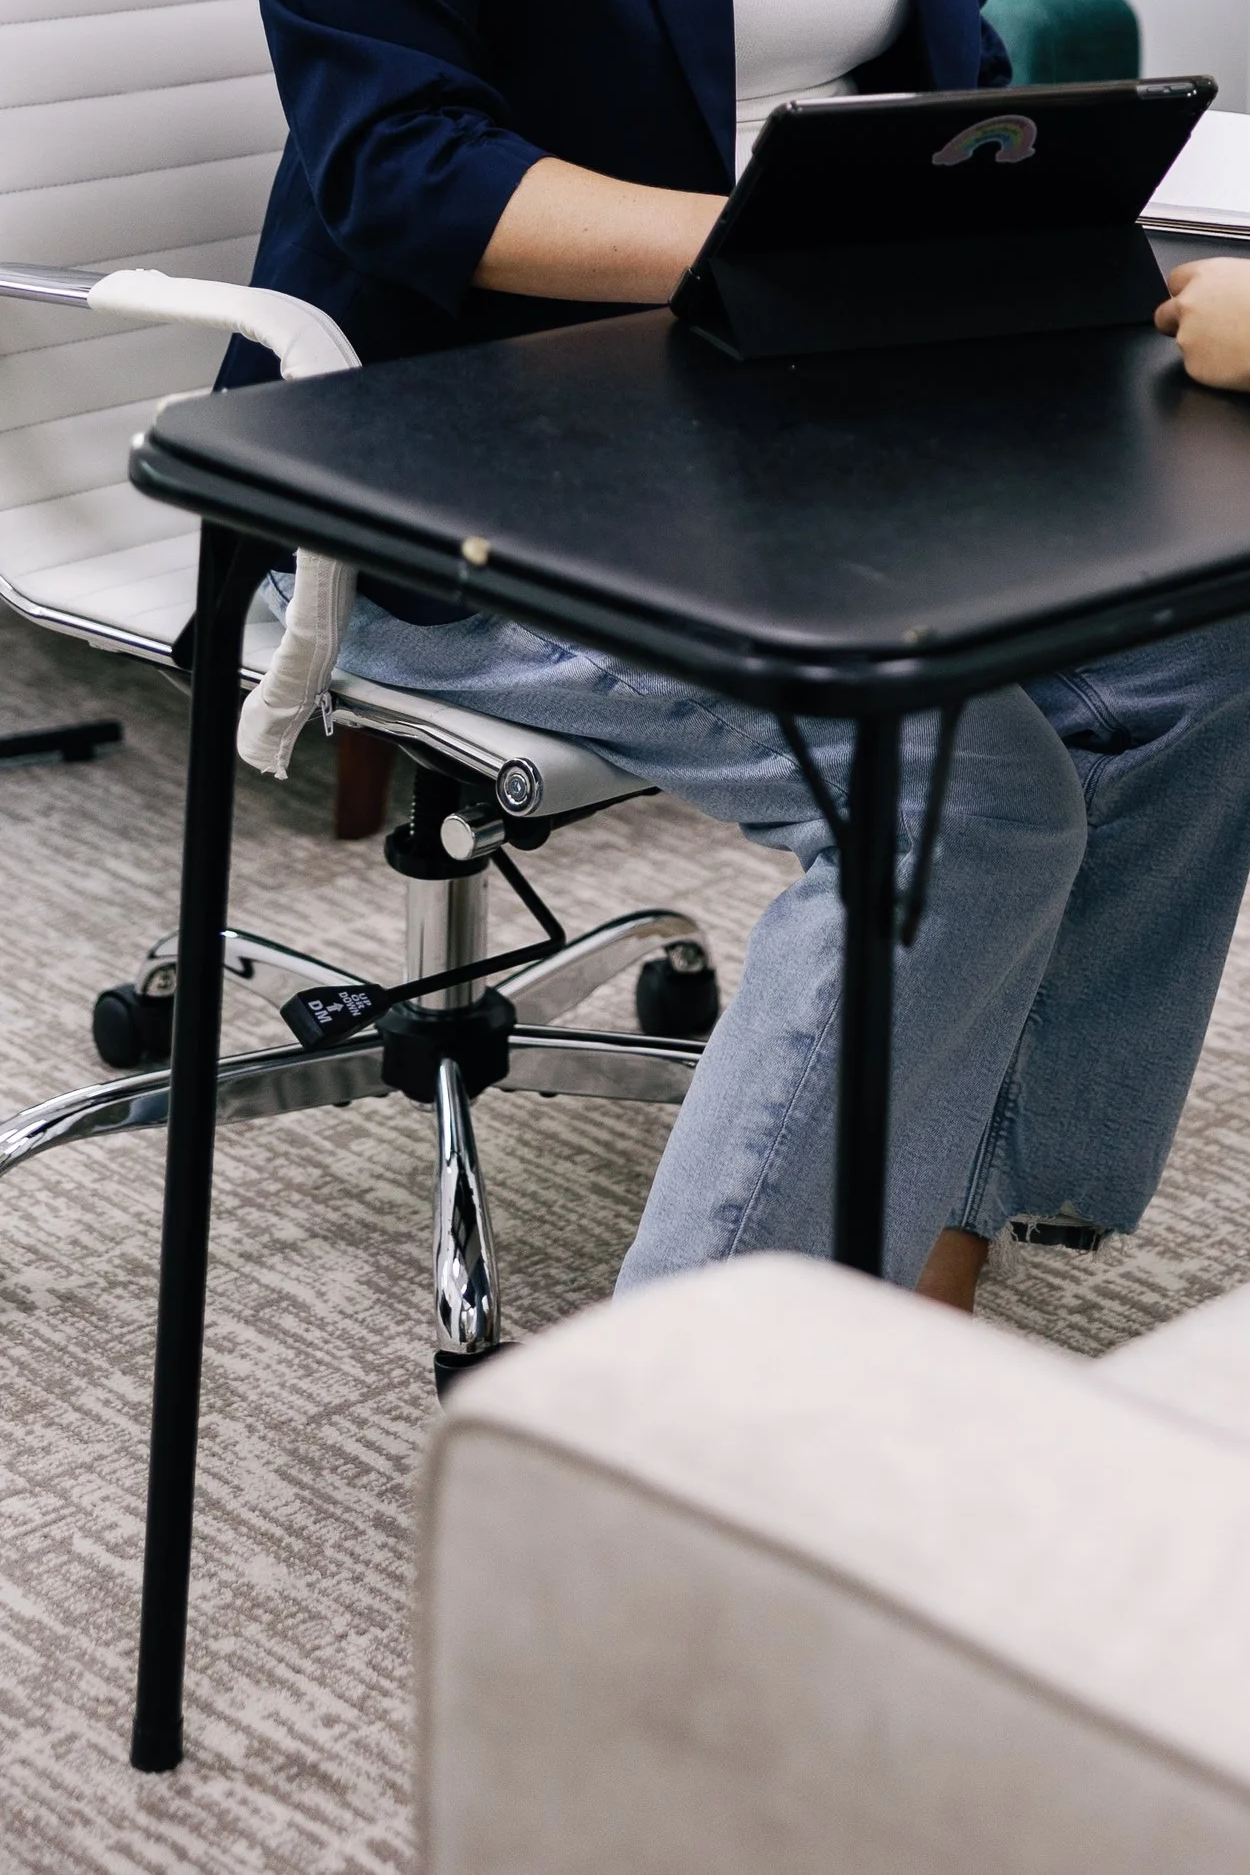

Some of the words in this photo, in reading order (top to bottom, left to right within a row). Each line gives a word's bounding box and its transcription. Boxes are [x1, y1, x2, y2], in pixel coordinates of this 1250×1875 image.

[338, 992, 361, 1017] DOWN
[350, 994, 365, 1009] OR
[358, 993, 372, 1006] UP
[307, 1000, 333, 1023] DM
